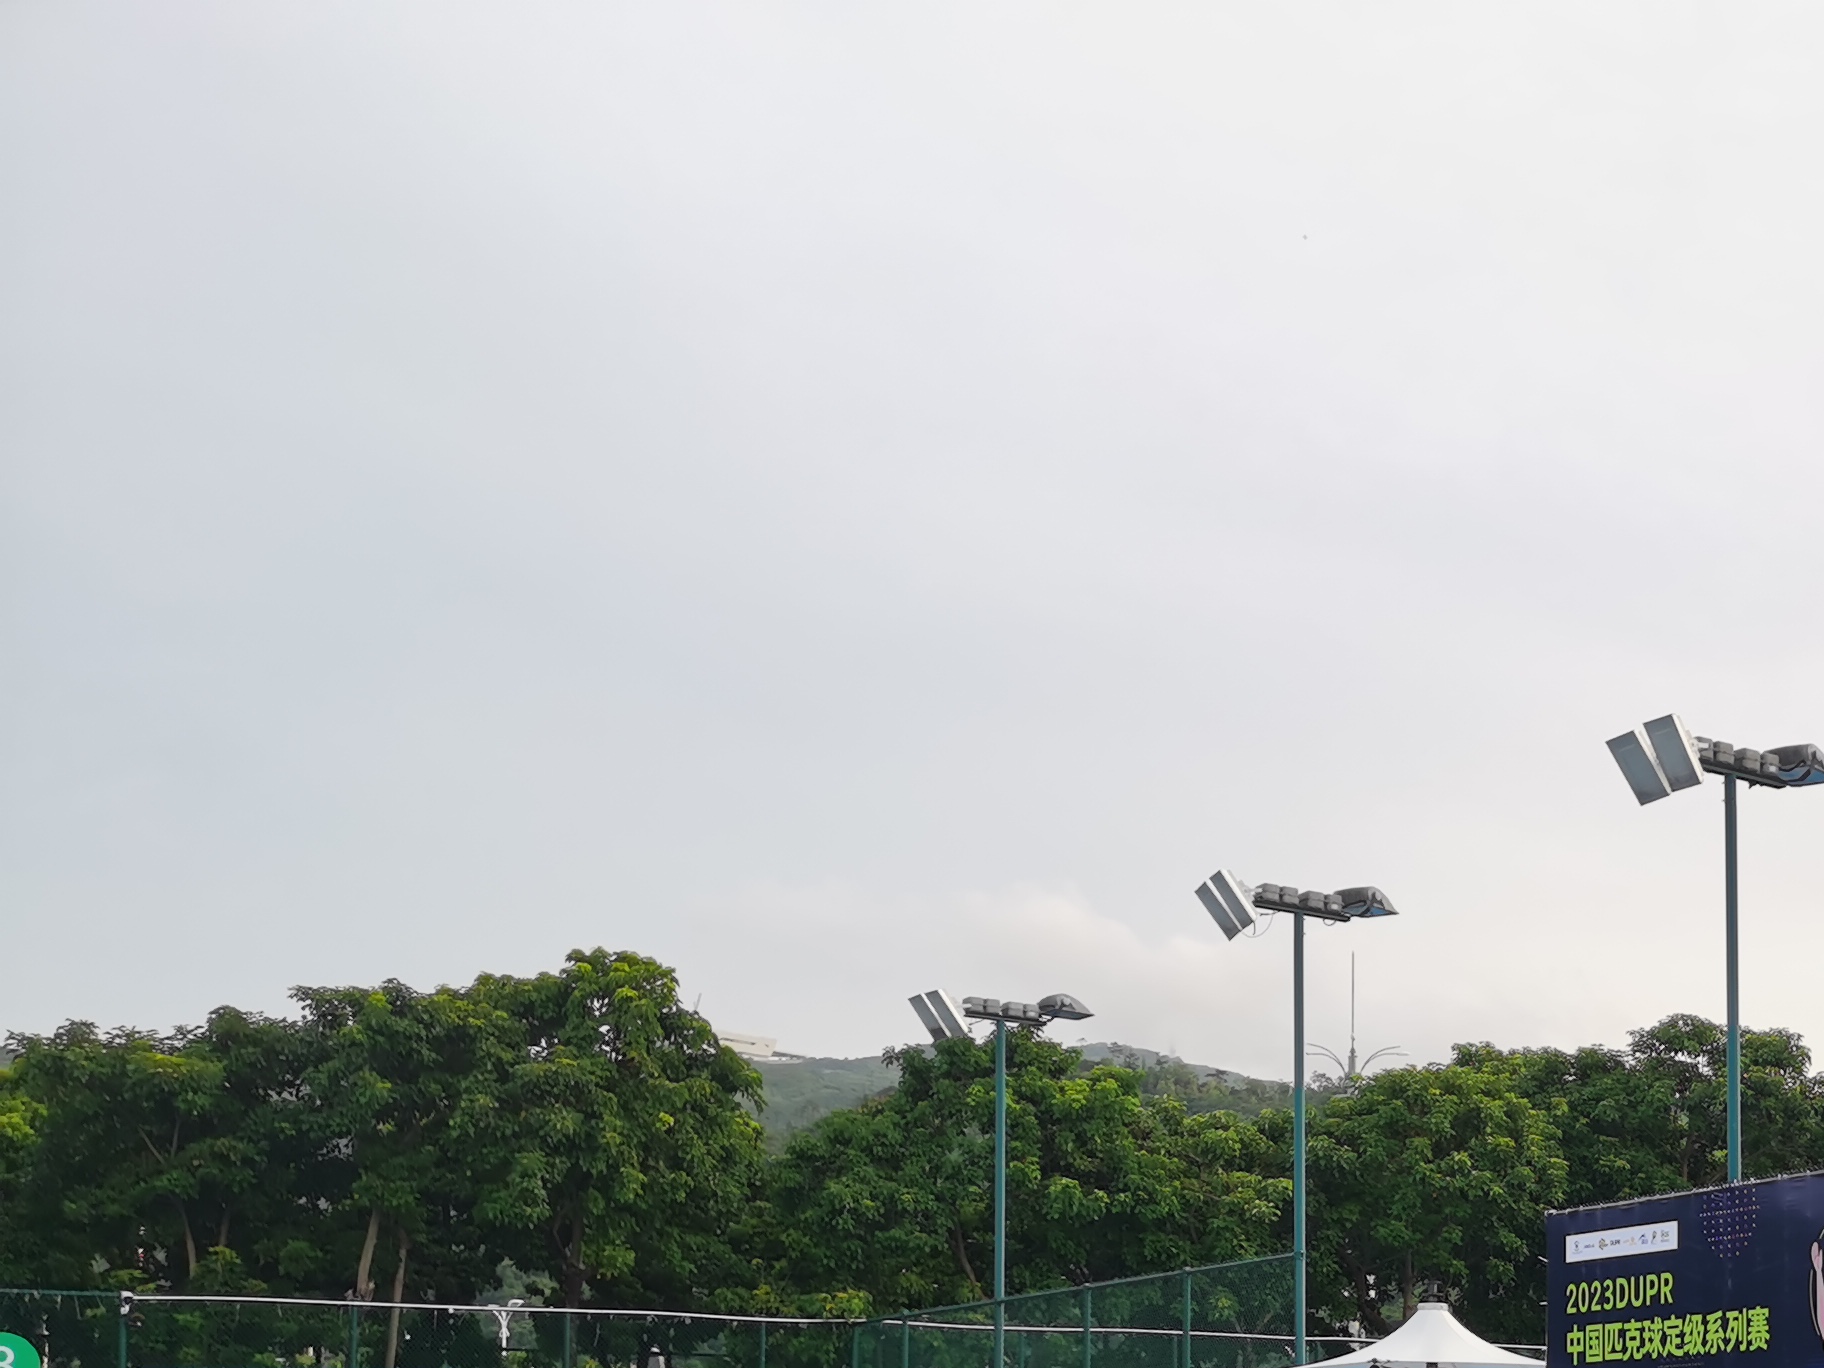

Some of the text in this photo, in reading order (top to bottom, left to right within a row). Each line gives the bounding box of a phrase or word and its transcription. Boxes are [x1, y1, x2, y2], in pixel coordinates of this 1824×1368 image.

[1565, 1272, 1674, 1315] 2023DUPR
[1565, 1305, 1771, 1366] 中国匹克球定级系列赛
